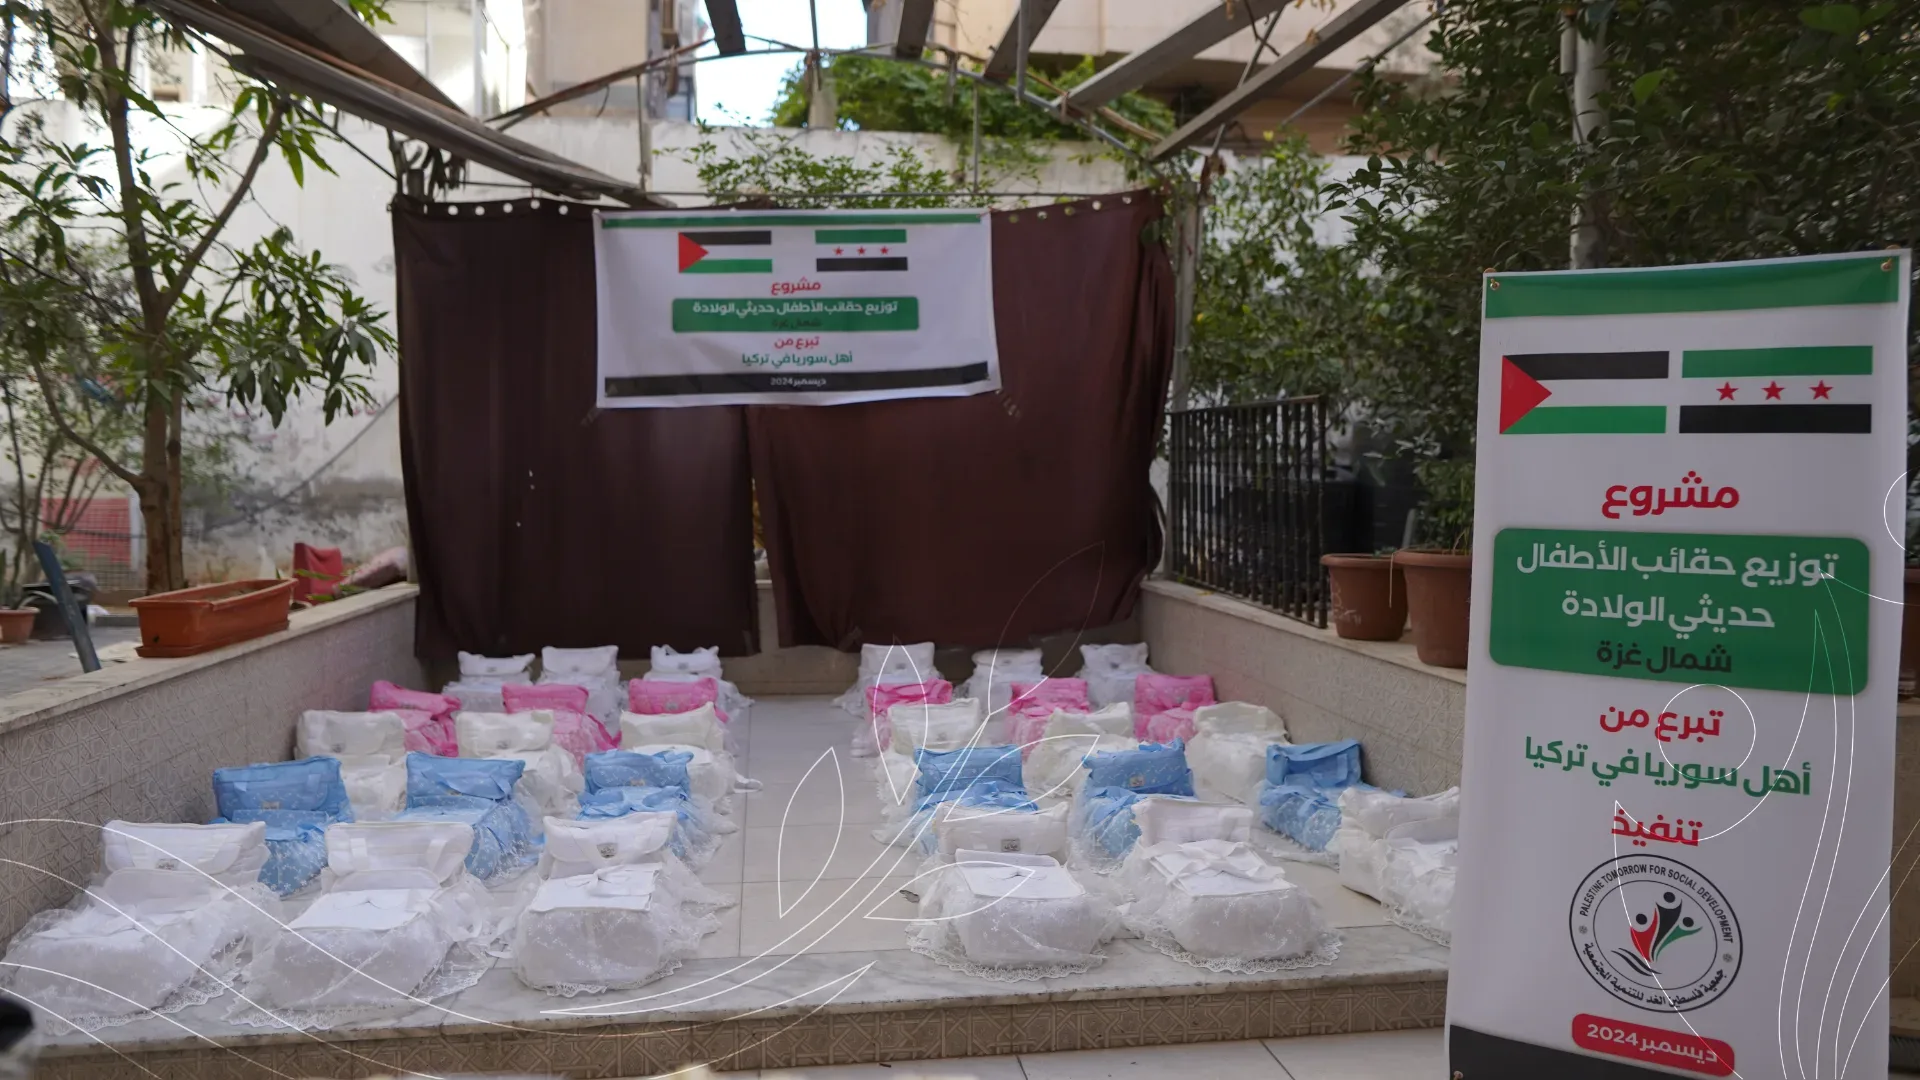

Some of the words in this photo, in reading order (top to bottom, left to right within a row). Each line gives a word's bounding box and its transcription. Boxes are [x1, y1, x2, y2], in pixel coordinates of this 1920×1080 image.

[771, 277, 821, 295] مشروع
[693, 301, 735, 315] الولادة
[736, 301, 775, 318] حديثي
[777, 300, 823, 315] الأطفال
[825, 301, 863, 315] حقائب
[865, 301, 899, 315] توزيع
[774, 337, 794, 349] من
[795, 336, 819, 349] تبرع
[742, 353, 769, 366] تركيا
[829, 351, 852, 365] أهل
[1601, 470, 1740, 520] مشروع
[1516, 540, 1627, 573] الأطفال
[1631, 547, 1736, 580] حقائب
[1741, 552, 1840, 588] توزيع
[1561, 590, 1664, 627] الولادة
[1668, 593, 1775, 640] حديثي
[1596, 640, 1642, 671] غزة
[1645, 643, 1733, 673] شمال
[1599, 705, 1650, 733] من
[1654, 709, 1724, 743] تبرع
[1524, 736, 1589, 771] تركيا
[1591, 748, 1640, 787] في
[1644, 752, 1738, 789] سوريا
[1743, 761, 1812, 798] أهل
[1611, 809, 1703, 847] تنفيذ
[1579, 879, 1605, 917] PALESTINE
[1601, 864, 1648, 884] TOMORROW
[1649, 864, 1666, 876] FOR
[1667, 869, 1698, 891] SOCIAL
[1697, 886, 1734, 944] DEVELOPMENT
[1610, 976, 1644, 1001] للتنمية
[1700, 969, 1727, 993] جمعية
[1668, 988, 1705, 1007] فلسطين
[1586, 1023, 1639, 1047] 2024
[1639, 1038, 1718, 1065] ديسمبر
